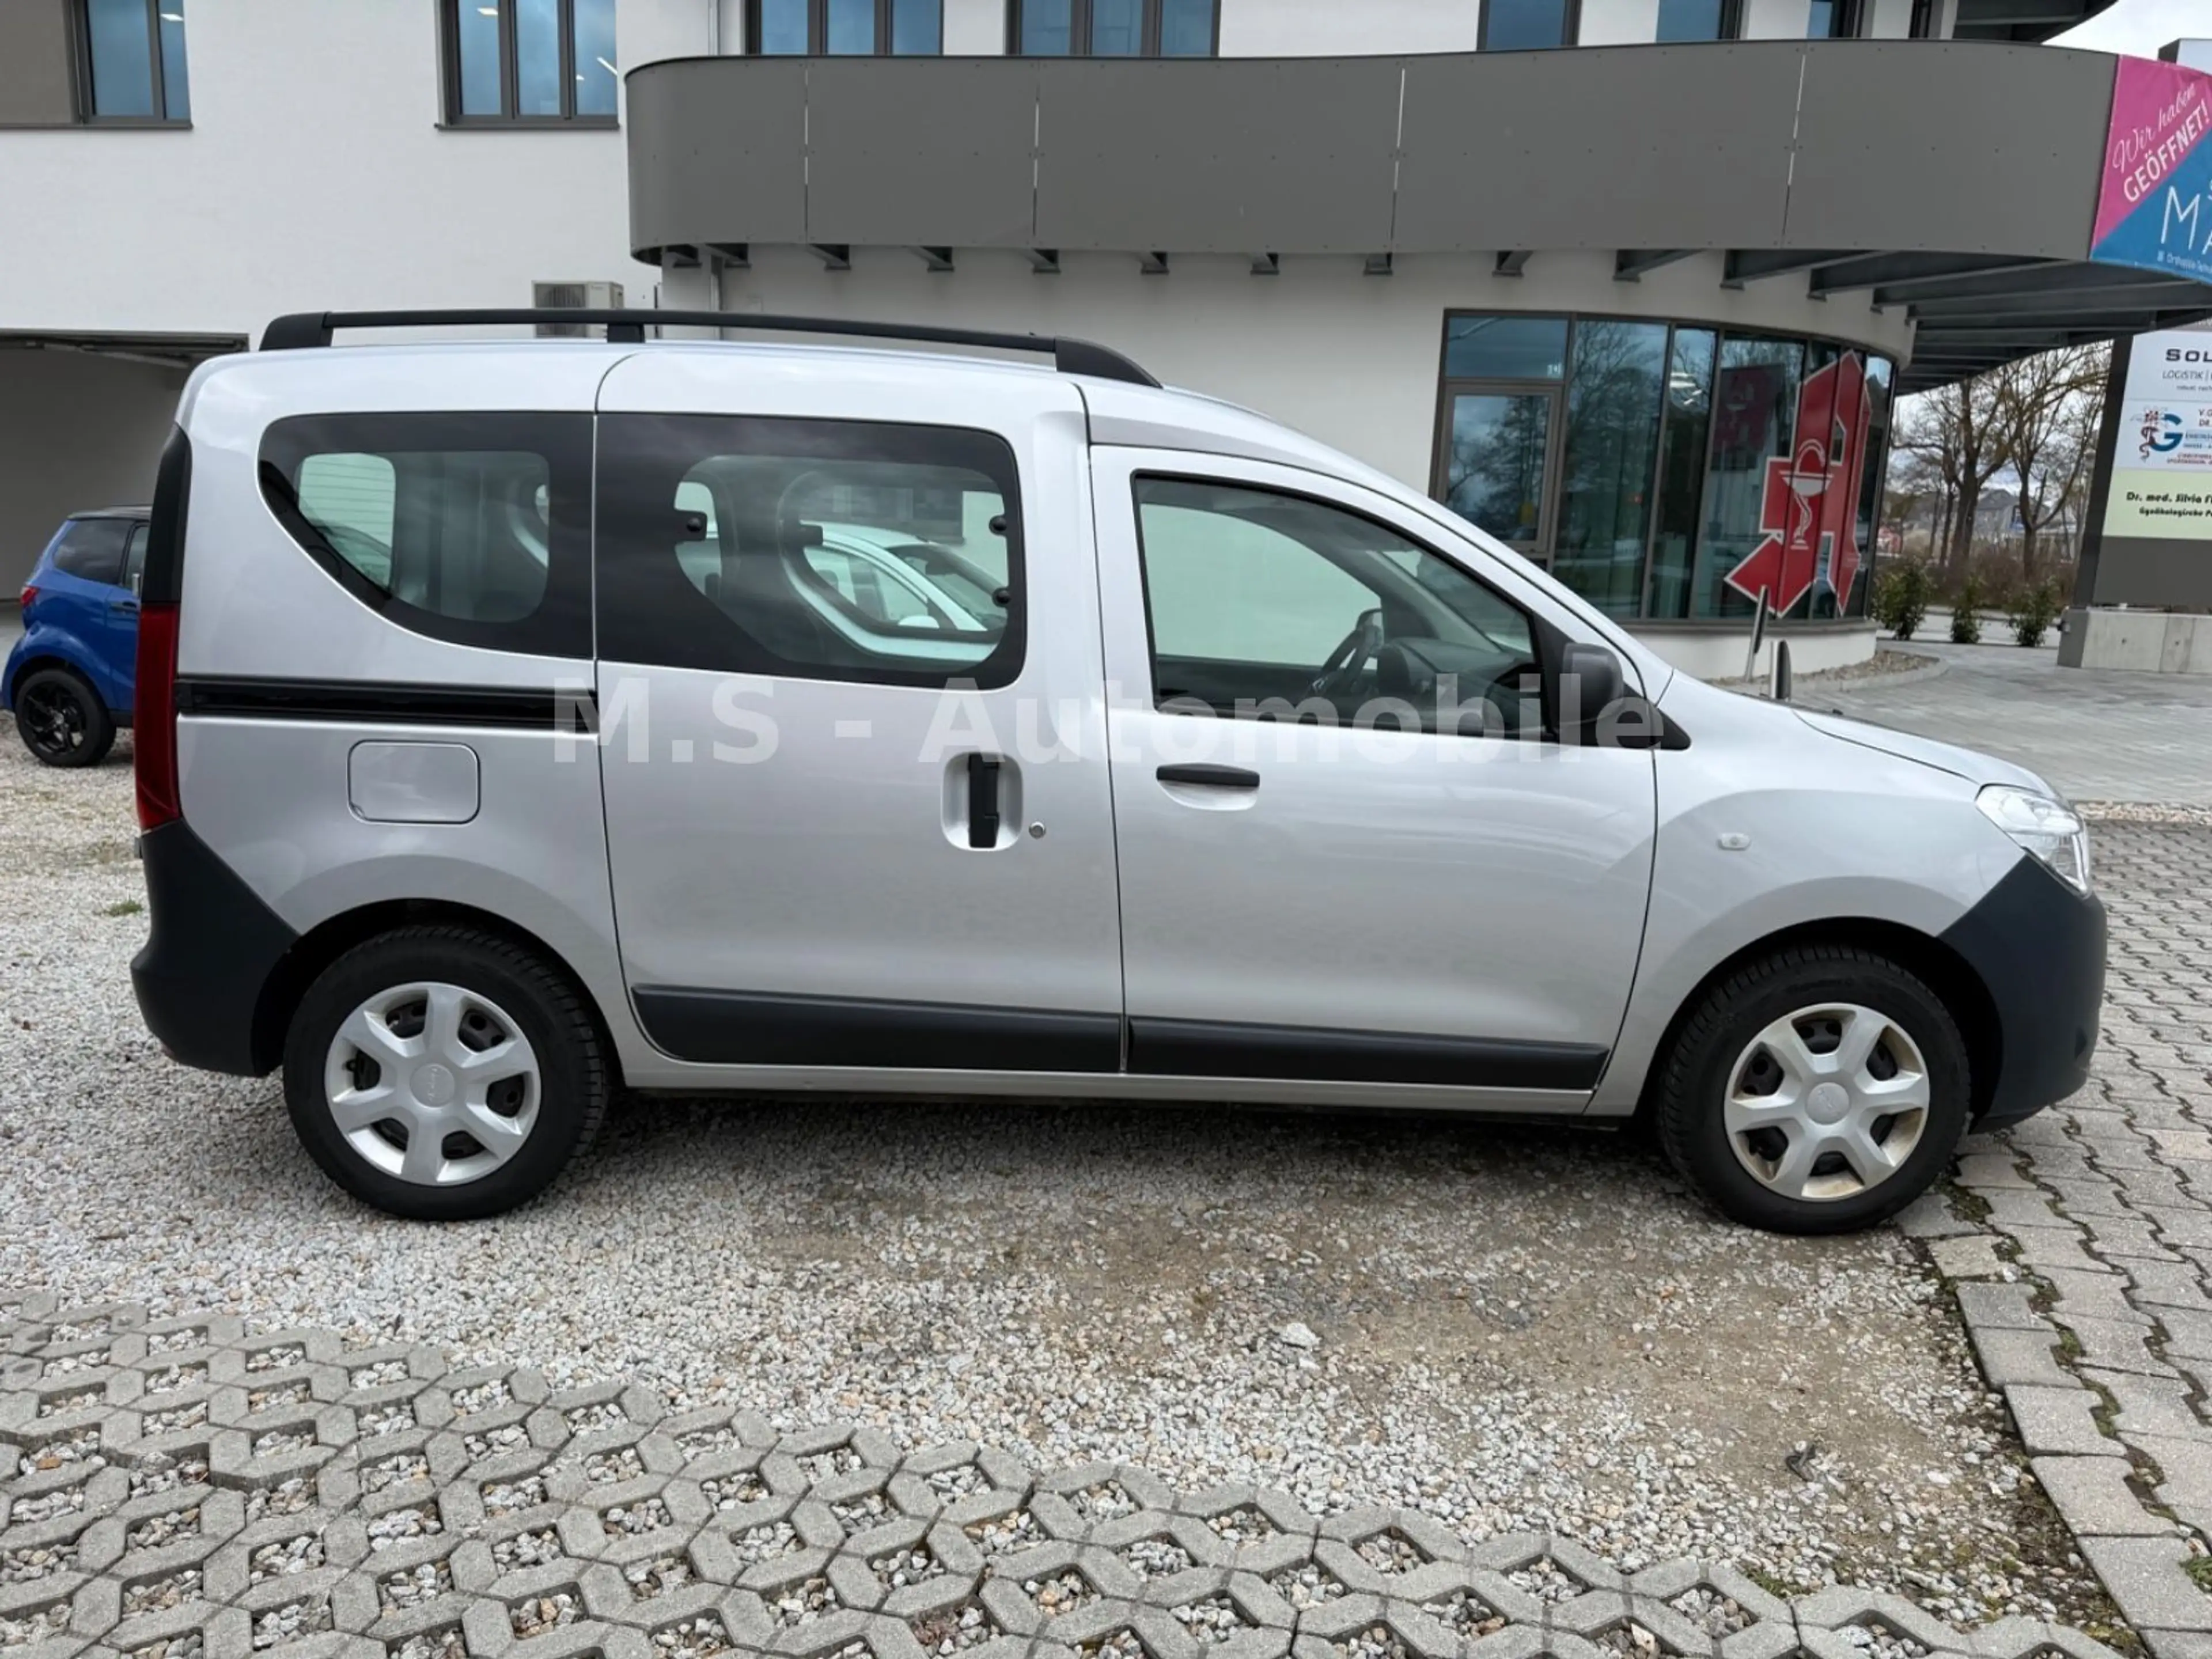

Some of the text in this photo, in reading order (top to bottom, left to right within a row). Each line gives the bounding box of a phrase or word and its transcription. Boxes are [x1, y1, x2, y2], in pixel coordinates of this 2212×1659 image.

[2112, 82, 2196, 173] Wir haben
[2123, 98, 2210, 202] GEÖFFNET!
[2126, 491, 2142, 501] Dr.
[2145, 493, 2172, 502] med.
